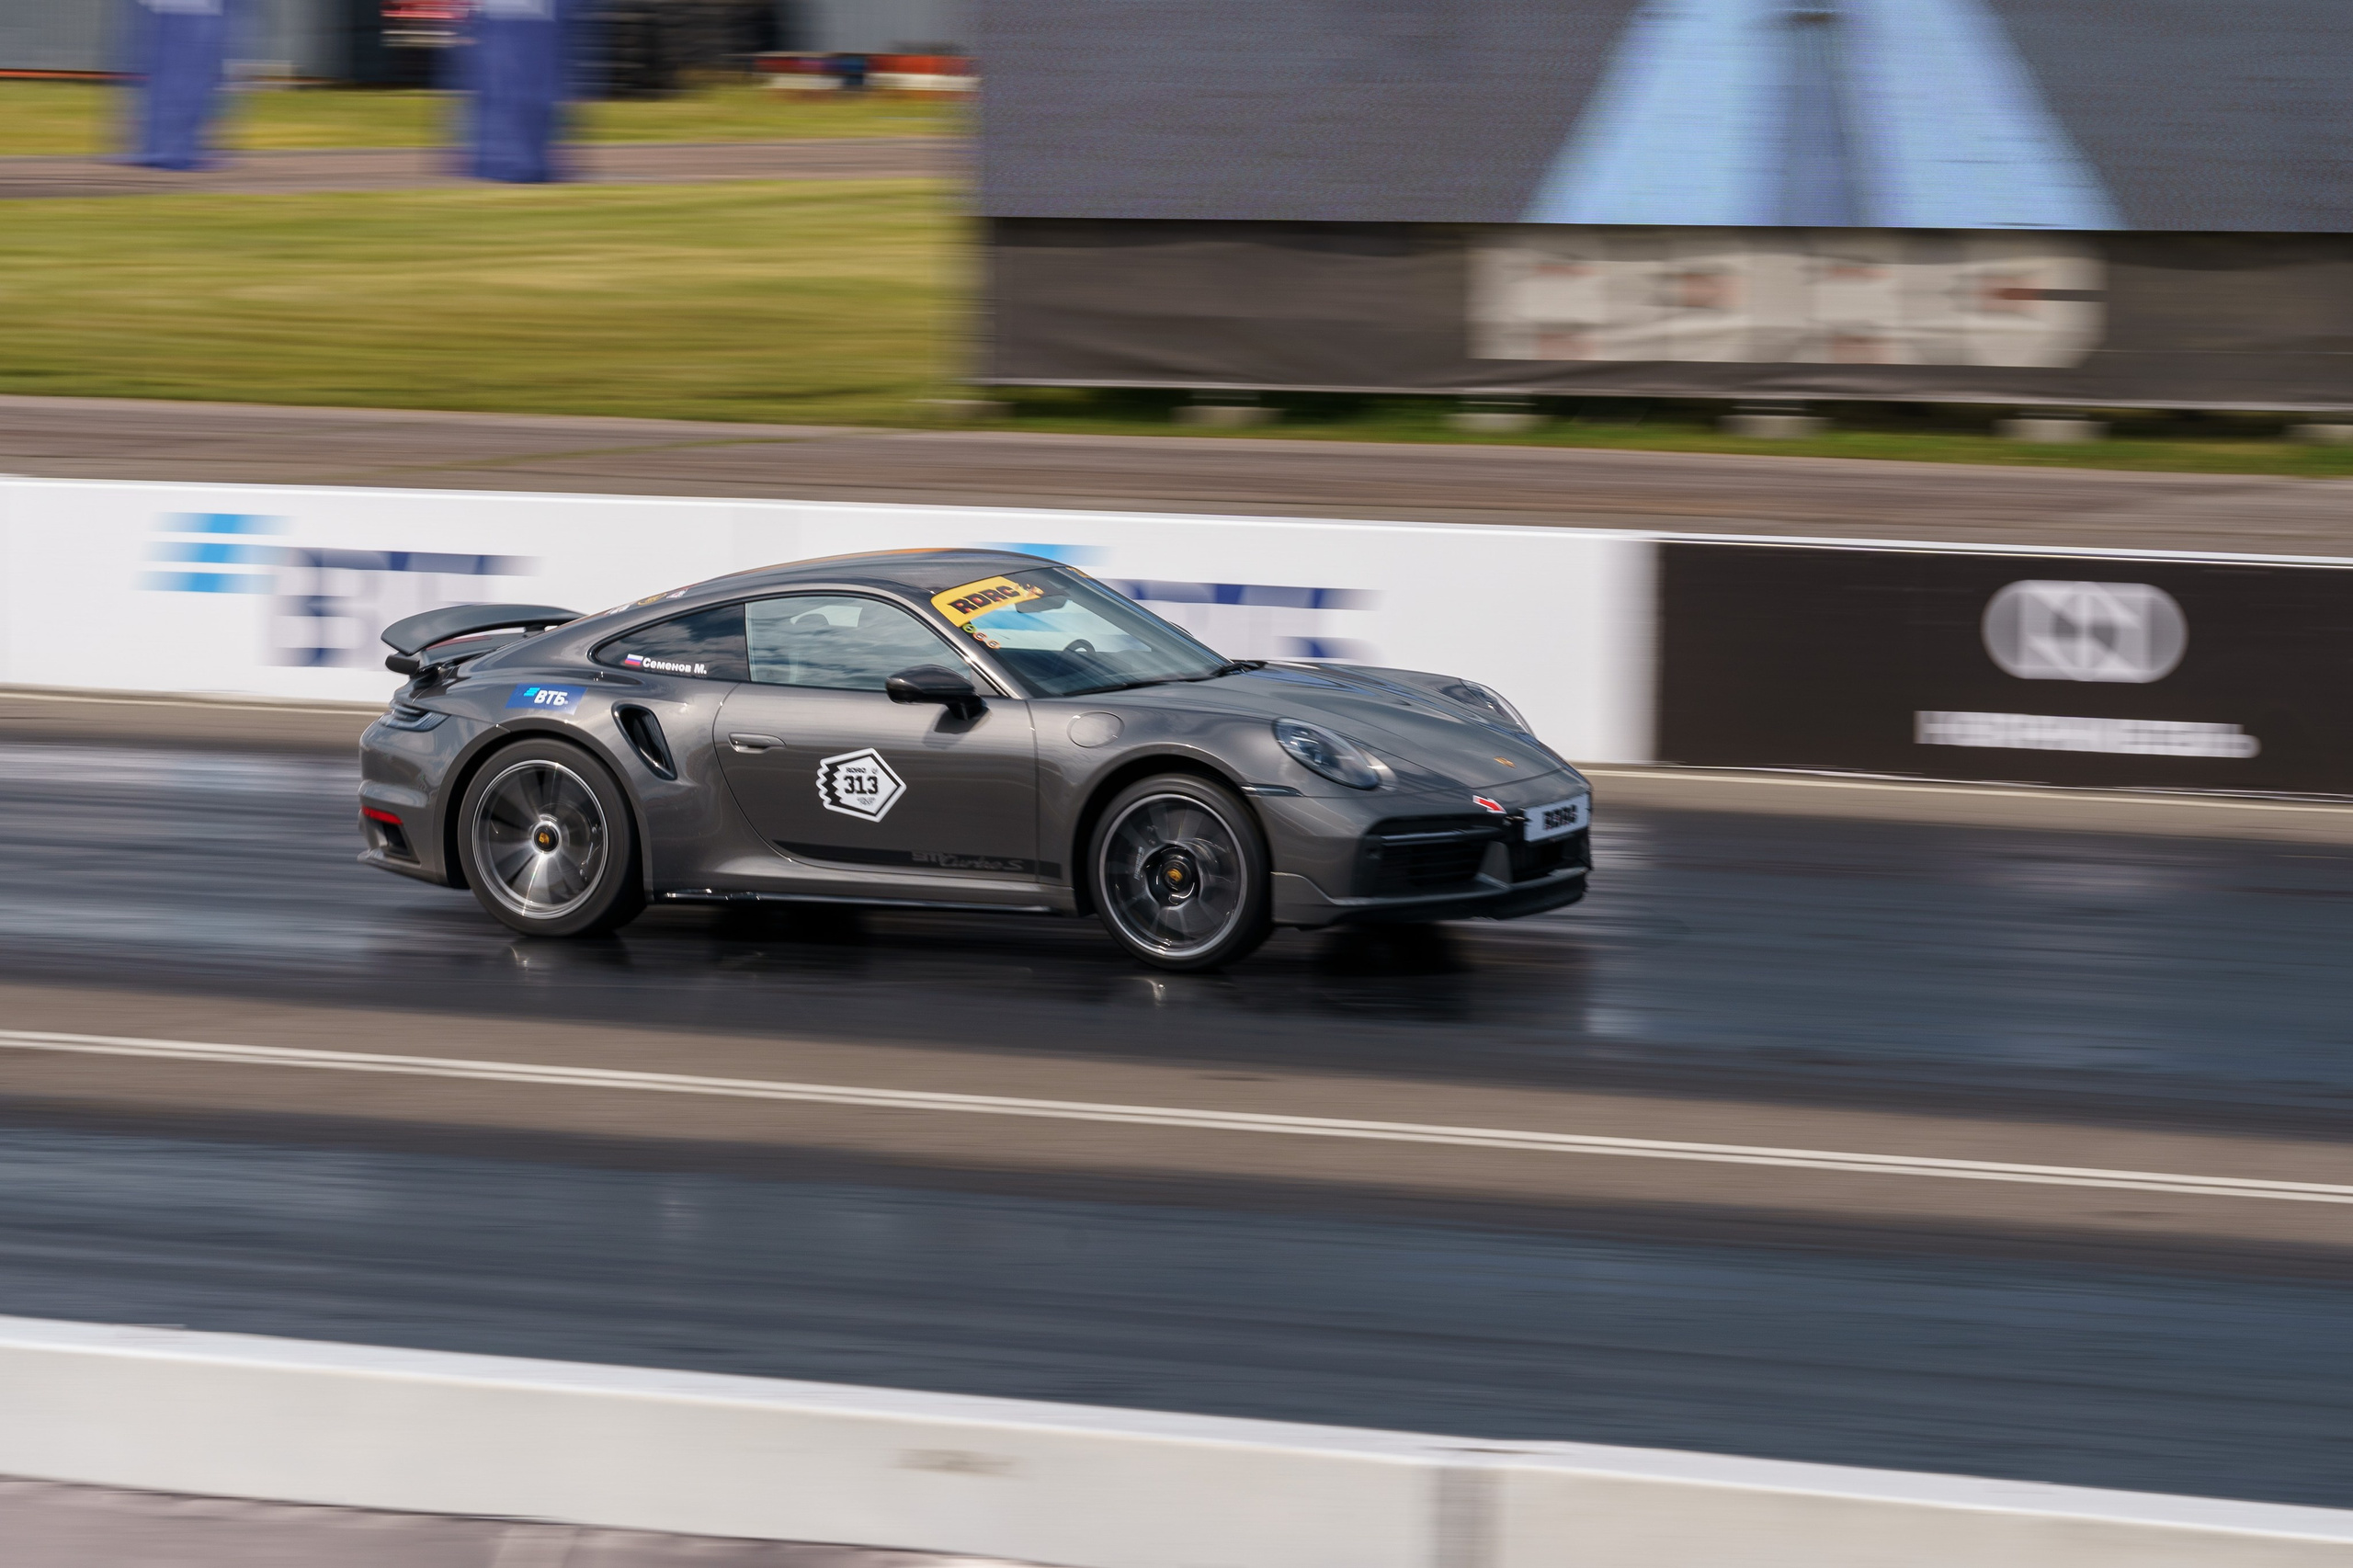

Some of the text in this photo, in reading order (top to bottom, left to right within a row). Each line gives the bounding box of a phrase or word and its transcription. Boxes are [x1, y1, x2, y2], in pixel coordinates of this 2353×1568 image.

[948, 585, 1020, 614] RDRC
[642, 657, 708, 675] Семенов М.
[534, 689, 568, 706] ВТБ
[844, 776, 879, 794] 313
